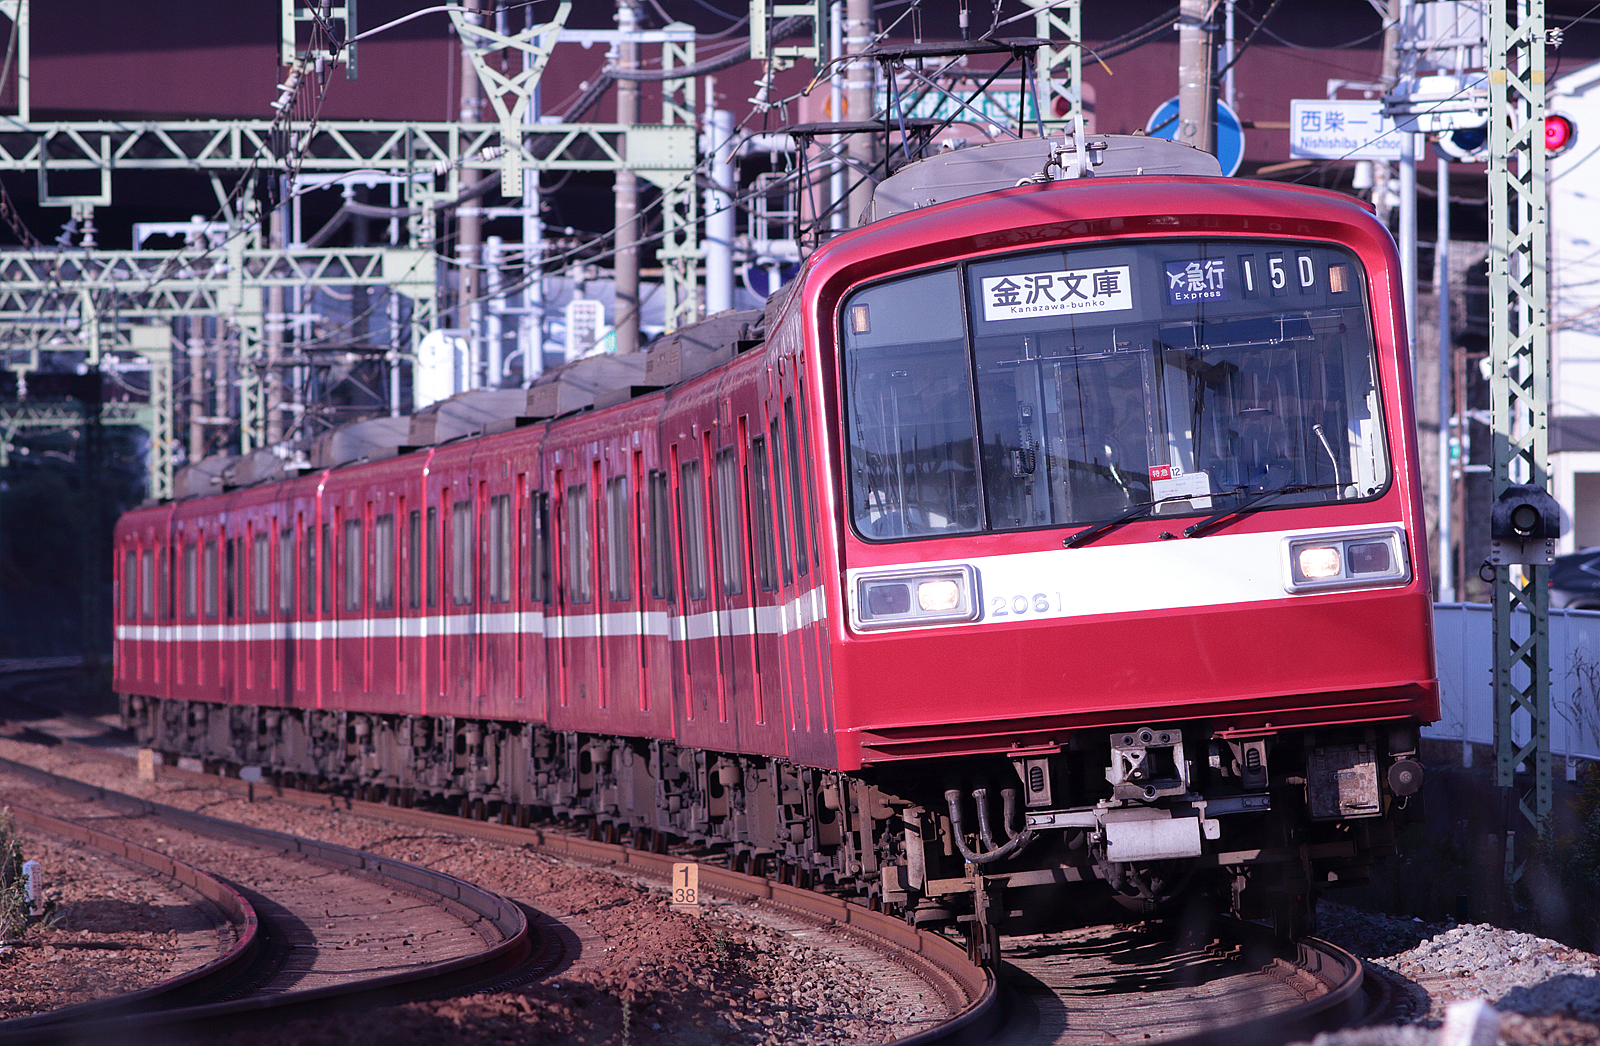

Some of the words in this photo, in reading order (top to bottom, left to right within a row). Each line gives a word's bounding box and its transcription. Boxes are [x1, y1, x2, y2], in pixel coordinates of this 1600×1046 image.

[1301, 110, 1401, 133] 西柴一丁
[1301, 137, 1358, 149] Nishishiba
[1363, 138, 1401, 150] 1-cho
[1185, 260, 1225, 292] 急行
[990, 269, 1122, 308] 金沢文庫
[1175, 290, 1222, 300] Express
[1010, 299, 1106, 313] Kanazawa-bunko
[1171, 467, 1181, 477] 12
[991, 592, 1062, 617] 2061
[679, 866, 689, 888] 1
[675, 888, 696, 903] 38
